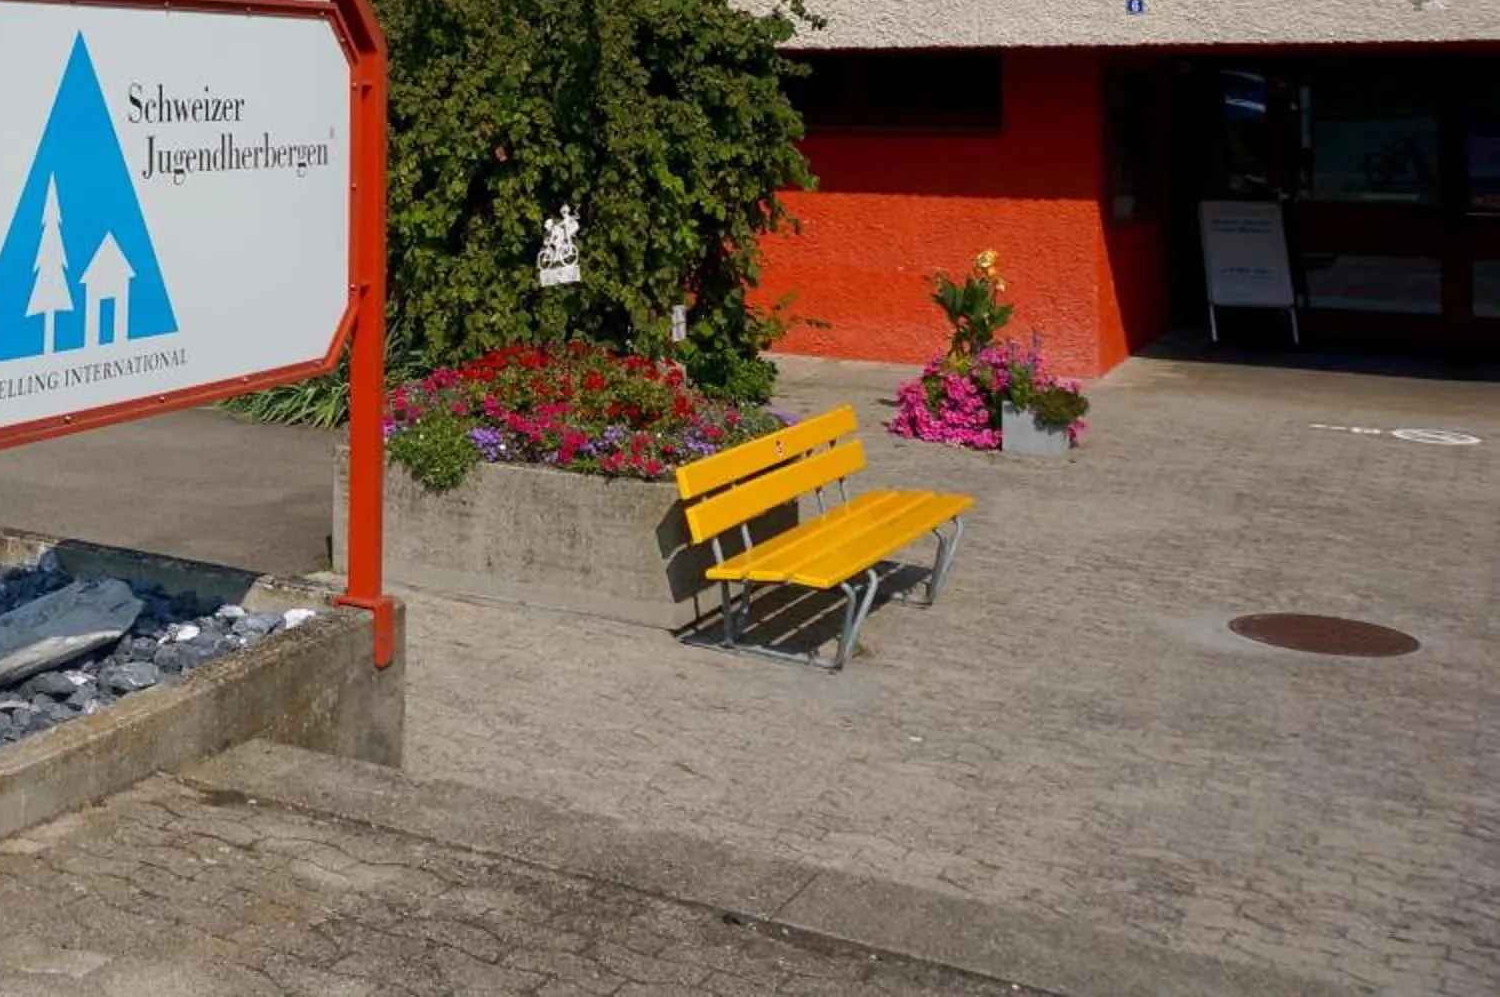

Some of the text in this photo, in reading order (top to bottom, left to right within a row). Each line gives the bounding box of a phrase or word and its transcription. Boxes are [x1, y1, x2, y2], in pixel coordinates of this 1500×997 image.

[127, 81, 246, 124] Schweizer
[141, 131, 329, 186] Jugendherbergen
[63, 347, 189, 388] INTERNATIONAL
